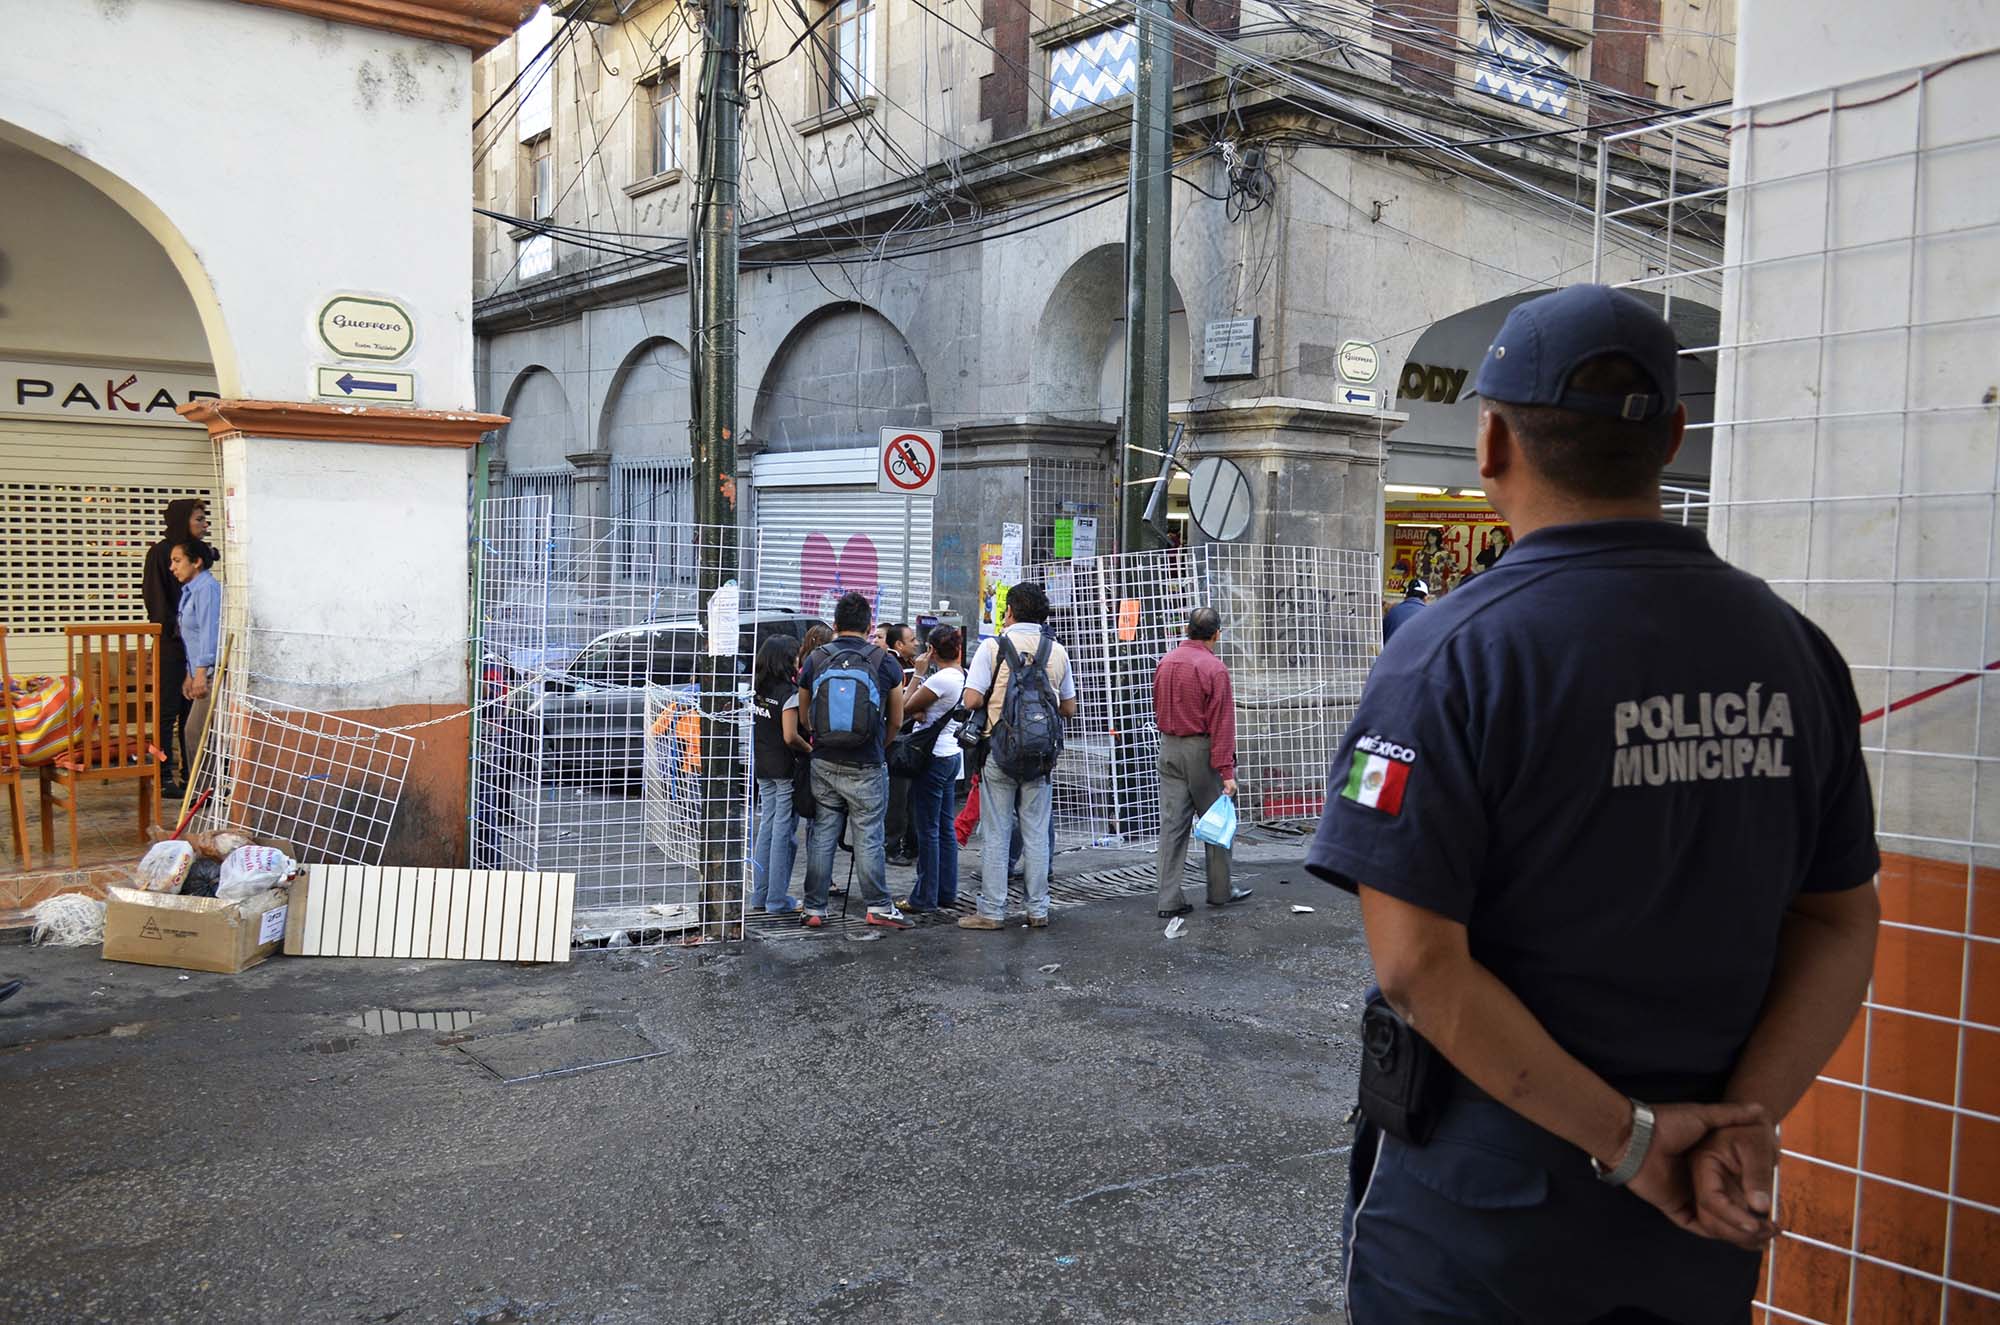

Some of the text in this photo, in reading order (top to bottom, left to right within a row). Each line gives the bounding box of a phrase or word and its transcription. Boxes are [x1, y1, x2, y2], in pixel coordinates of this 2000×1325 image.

[332, 314, 402, 332] Guerrero
[1396, 362, 1470, 405] ODY
[1614, 682, 1794, 746] POLICÍA
[1356, 735, 1416, 763] MÉXICO
[1612, 738, 1791, 787] MUNICIPAL
